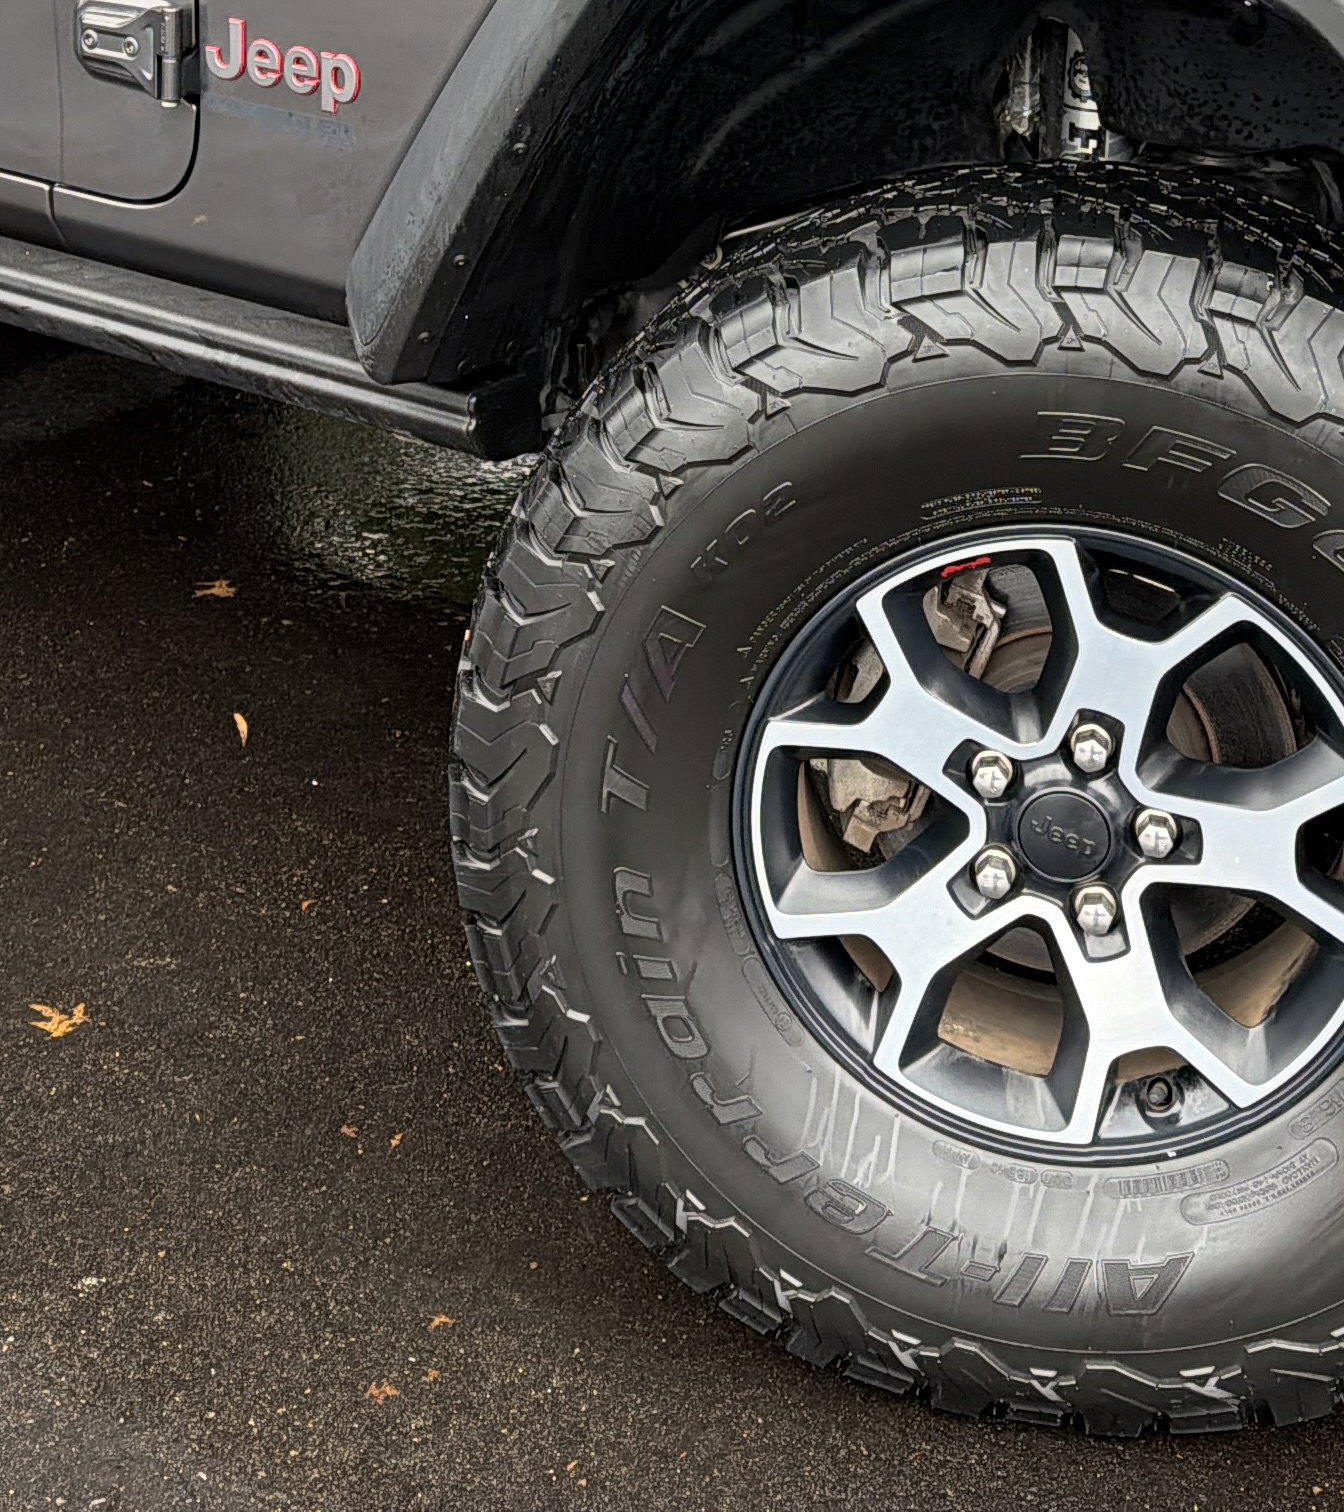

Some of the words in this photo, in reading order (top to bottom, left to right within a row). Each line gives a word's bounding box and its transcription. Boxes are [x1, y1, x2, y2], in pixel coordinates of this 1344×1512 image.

[204, 17, 362, 114] Jeep
[599, 604, 707, 814] T/A
[1031, 815, 1097, 856] Jeep
[613, 866, 1196, 1318] All-Terrain
